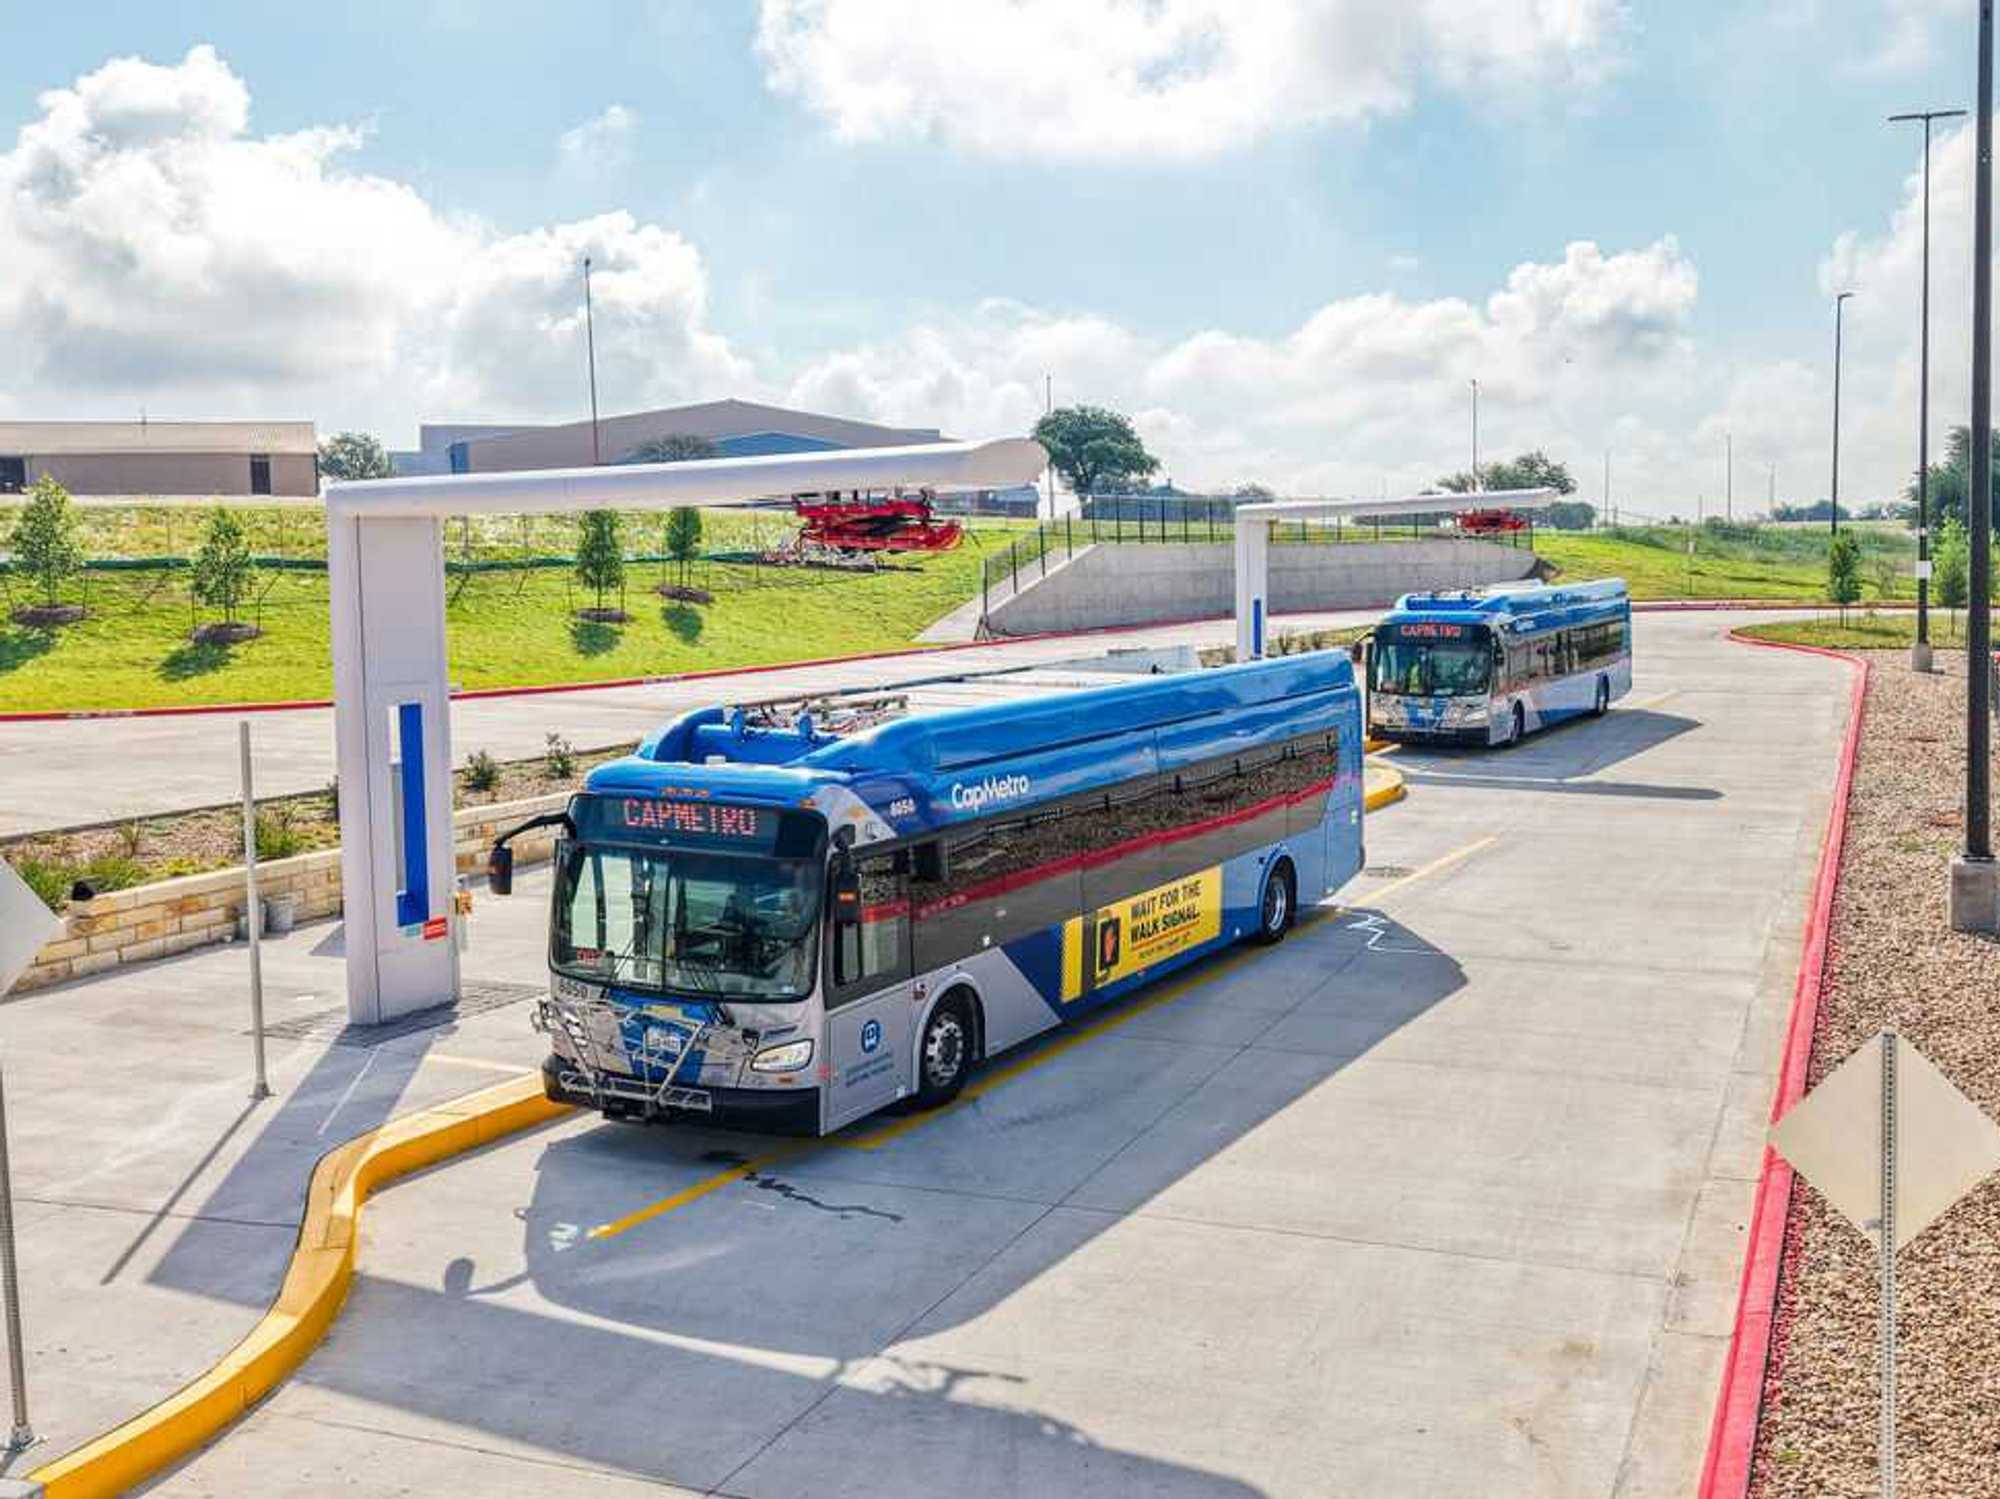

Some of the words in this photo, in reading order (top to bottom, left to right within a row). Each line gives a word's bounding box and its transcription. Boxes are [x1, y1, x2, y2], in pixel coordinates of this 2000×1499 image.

[952, 773, 1030, 812] CapMetro
[624, 798, 757, 835] CAPMETRO
[1131, 896, 1157, 919] WAIT
[1159, 887, 1180, 909] FOR
[1182, 879, 1202, 900] THE
[1131, 919, 1160, 943] WALK
